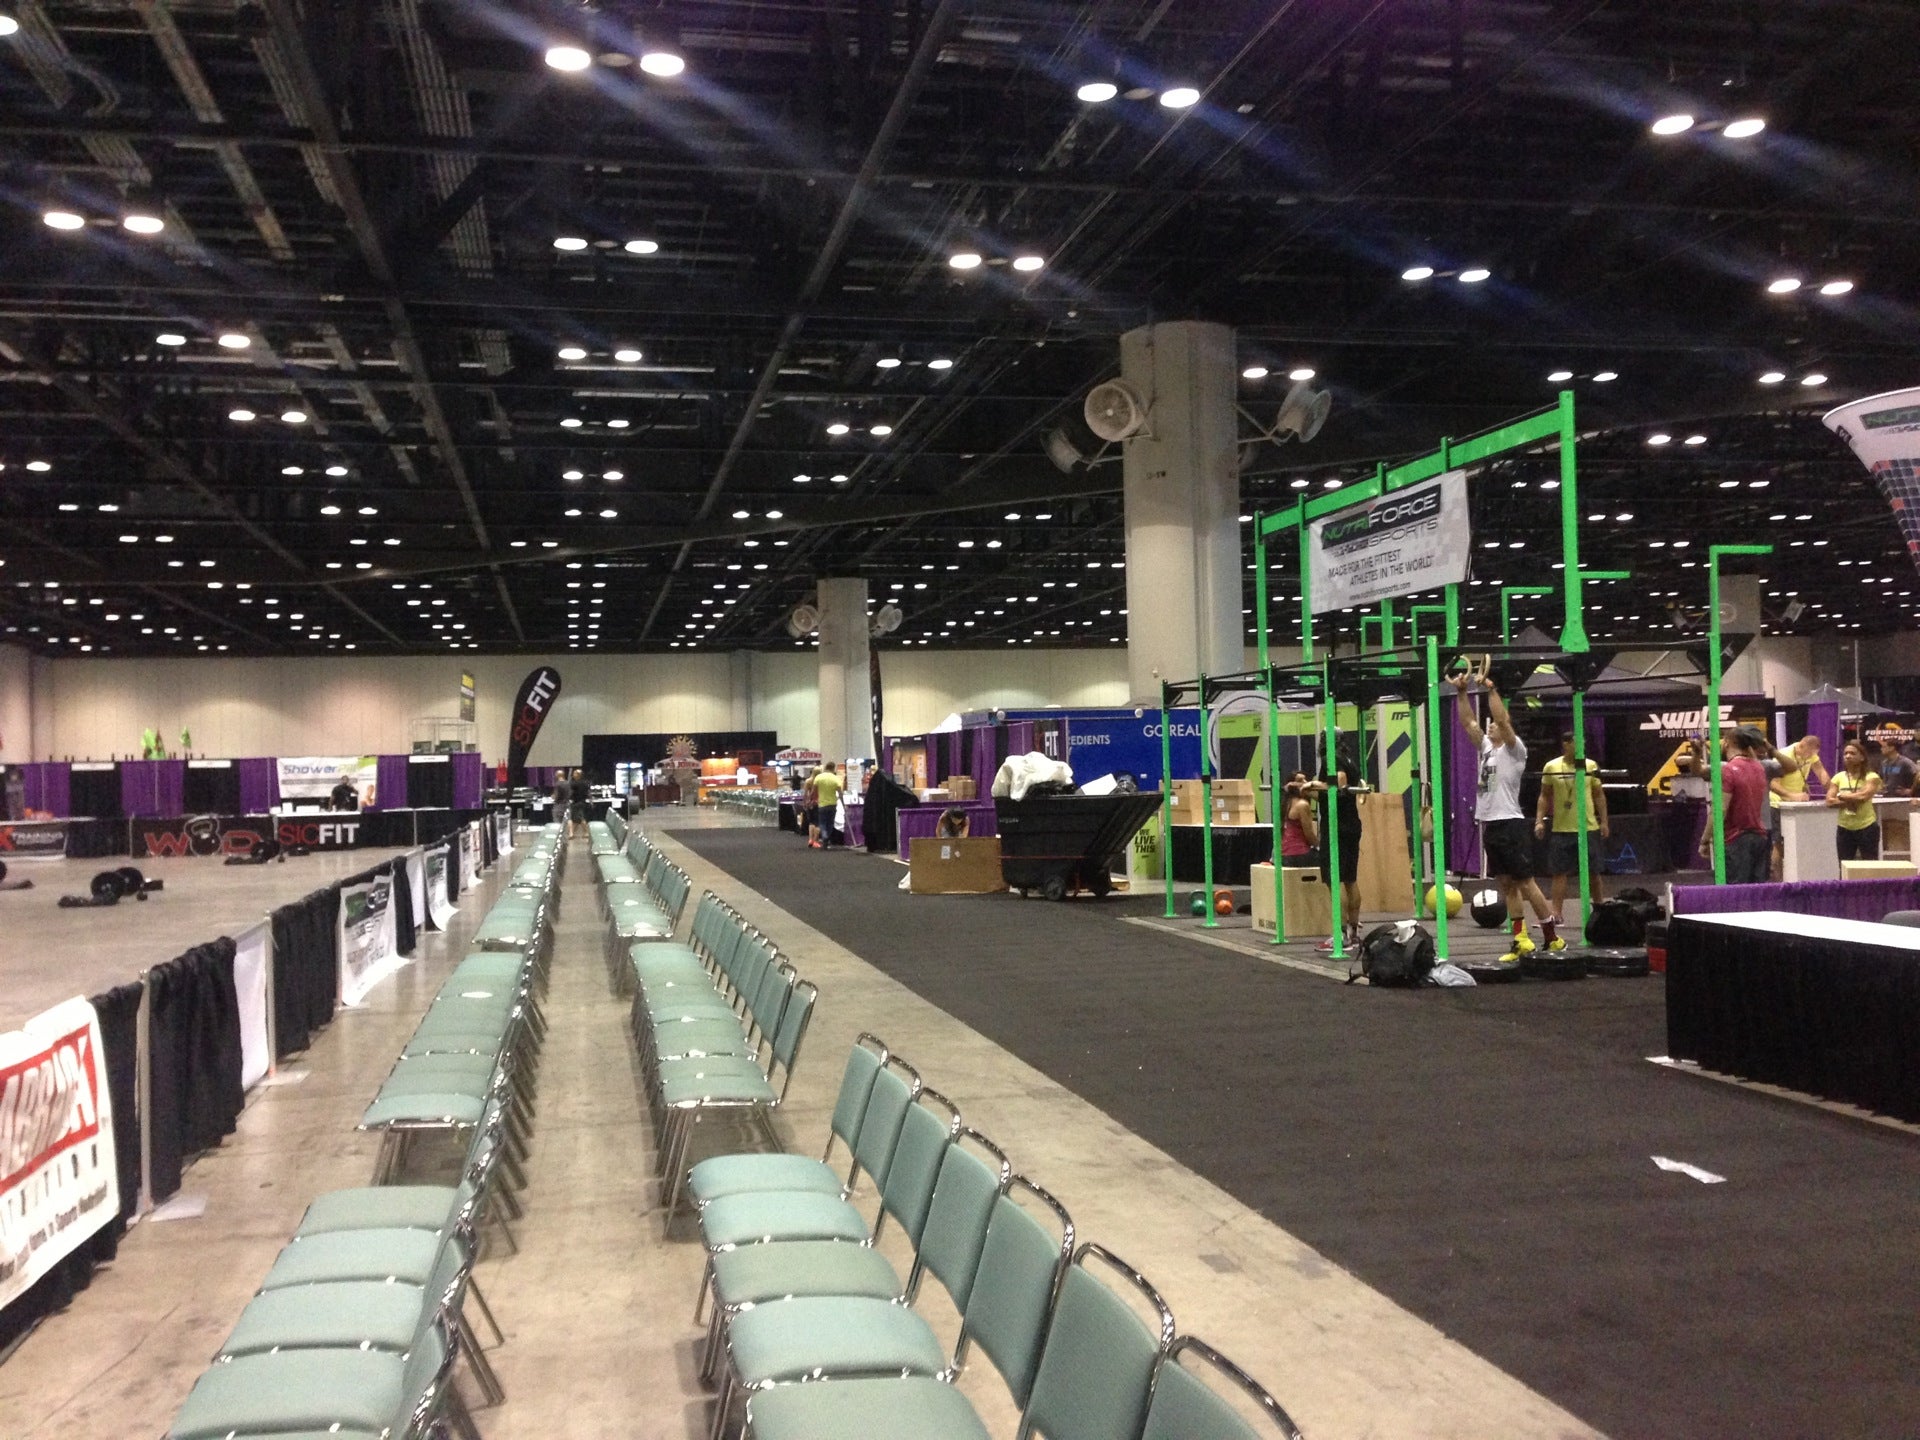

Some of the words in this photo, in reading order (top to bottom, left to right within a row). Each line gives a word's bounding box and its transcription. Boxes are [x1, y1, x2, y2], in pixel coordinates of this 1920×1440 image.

[1367, 517, 1438, 548] SPORTS
[1327, 563, 1347, 578] MADE
[1347, 560, 1360, 574] FOR
[1360, 555, 1374, 570] THE
[1374, 548, 1402, 567] FITTEST
[1349, 569, 1380, 586] ATHLETES
[1380, 567, 1389, 579] IN
[1390, 562, 1404, 575] THE
[513, 670, 557, 745] SICFIT
[1659, 729, 1684, 738] SPORTS
[278, 823, 360, 845] SICFIT
[1134, 835, 1156, 845] LIVE
[1135, 844, 1156, 854] THIS
